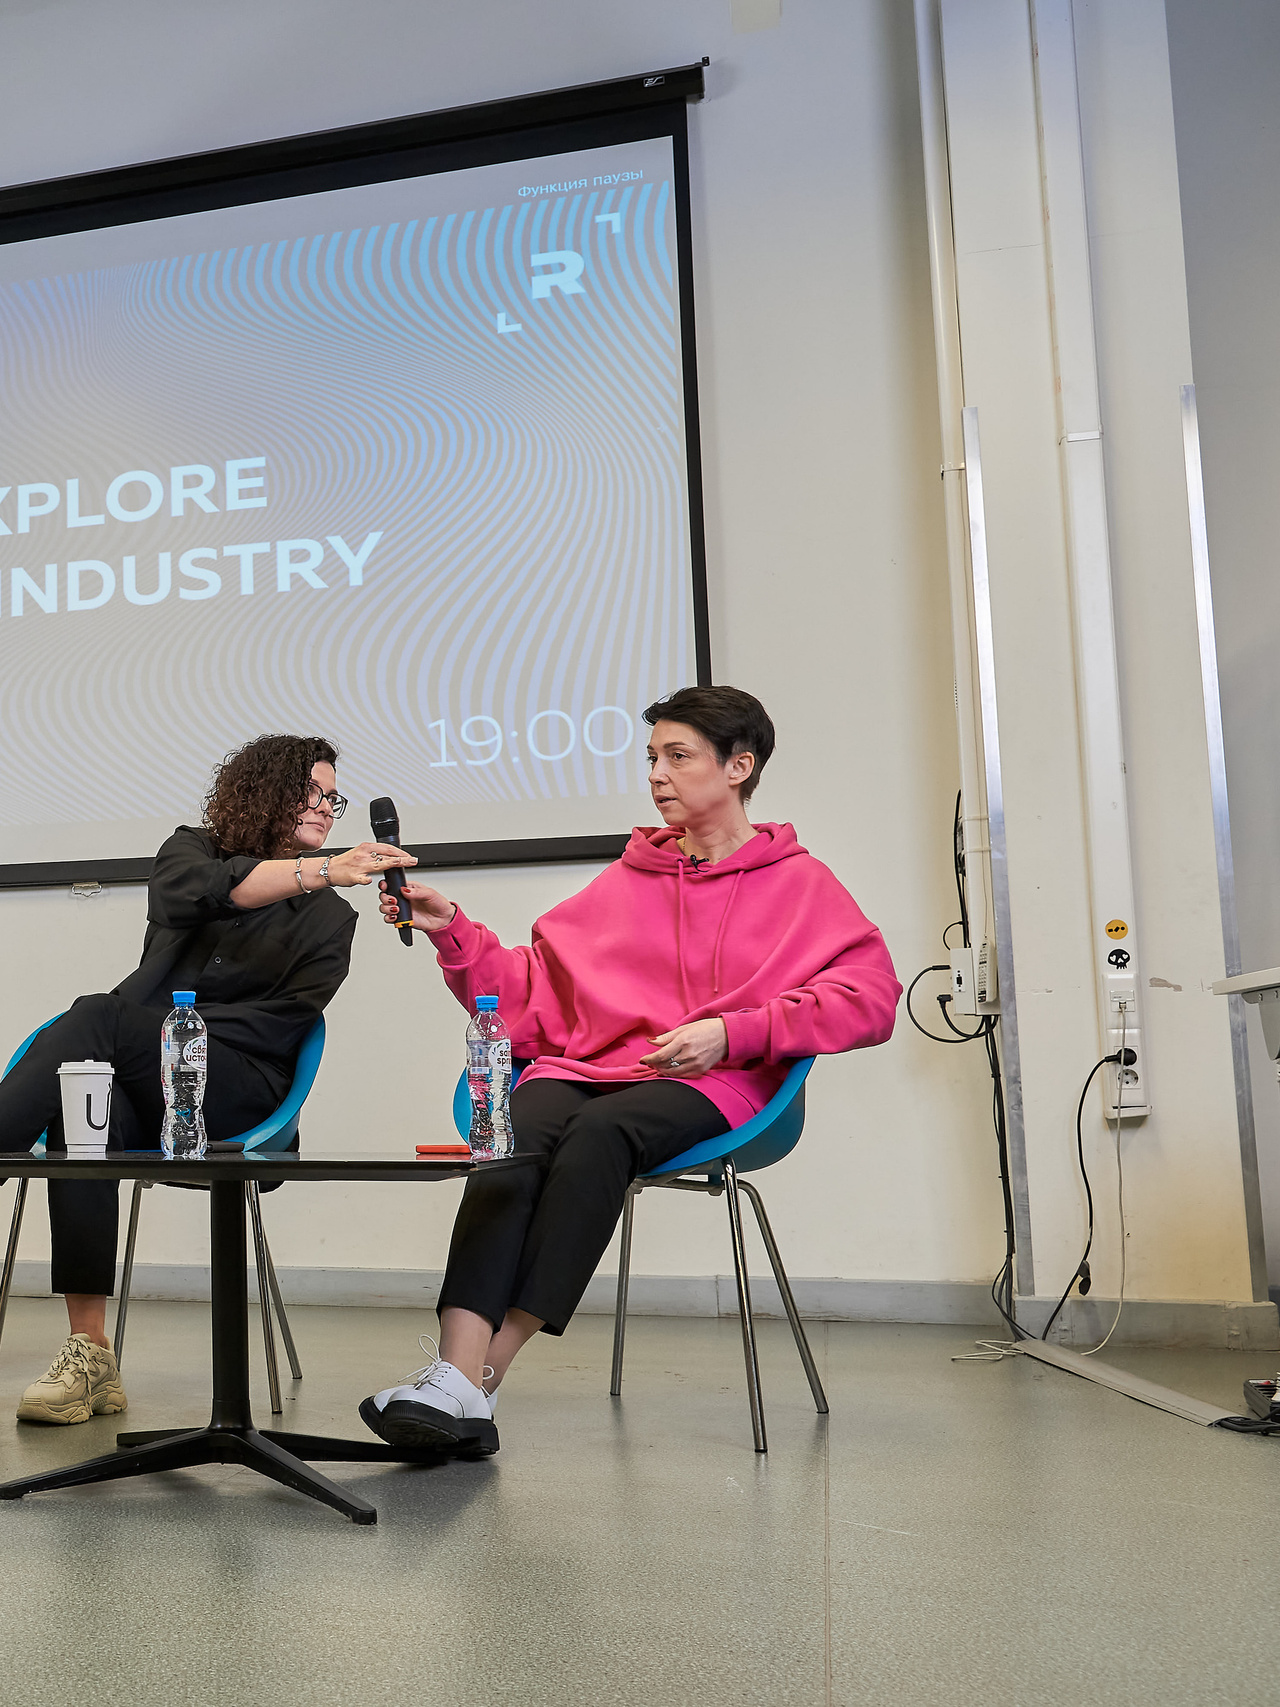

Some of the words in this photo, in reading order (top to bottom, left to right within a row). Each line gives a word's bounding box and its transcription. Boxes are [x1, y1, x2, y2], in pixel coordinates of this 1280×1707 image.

[518, 178, 588, 198] Функция
[593, 169, 644, 188] паузы
[427, 705, 635, 768] 19:00
